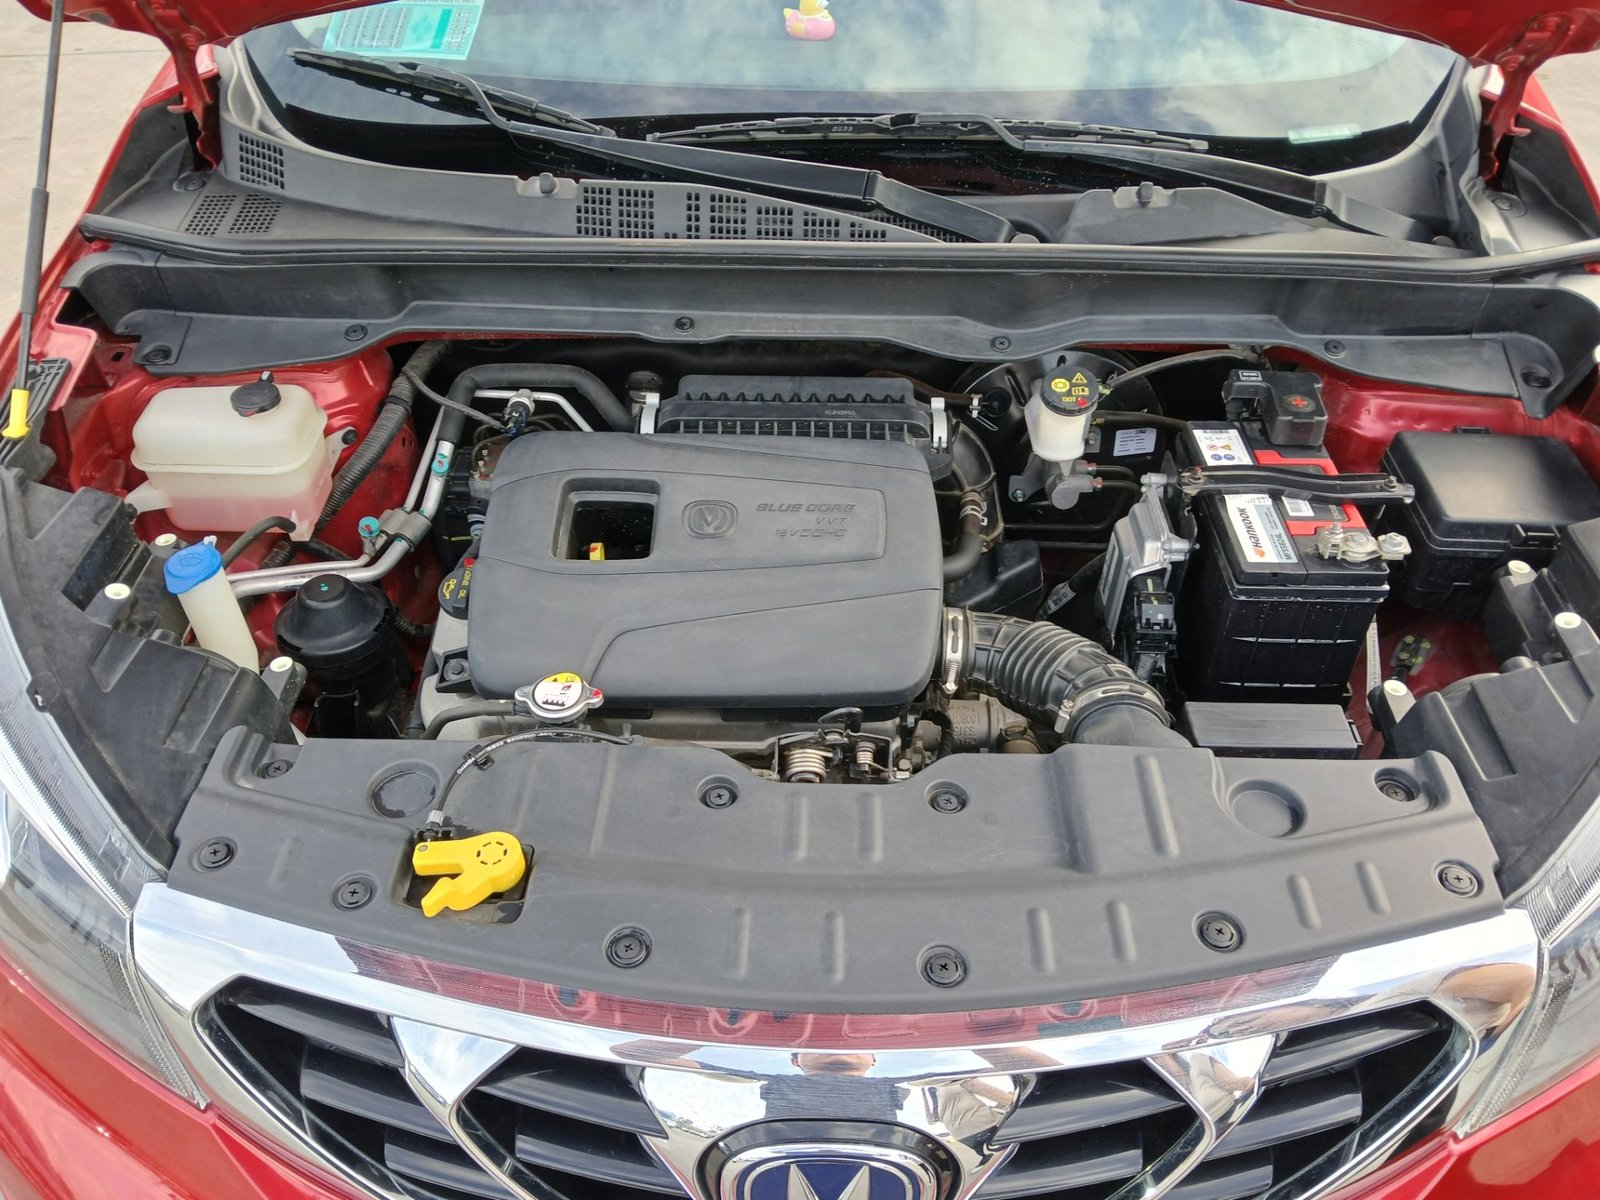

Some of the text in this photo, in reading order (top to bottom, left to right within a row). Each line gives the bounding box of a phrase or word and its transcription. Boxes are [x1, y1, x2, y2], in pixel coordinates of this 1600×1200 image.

[755, 503, 856, 513] BLUE CORE
[816, 516, 848, 525] VVT
